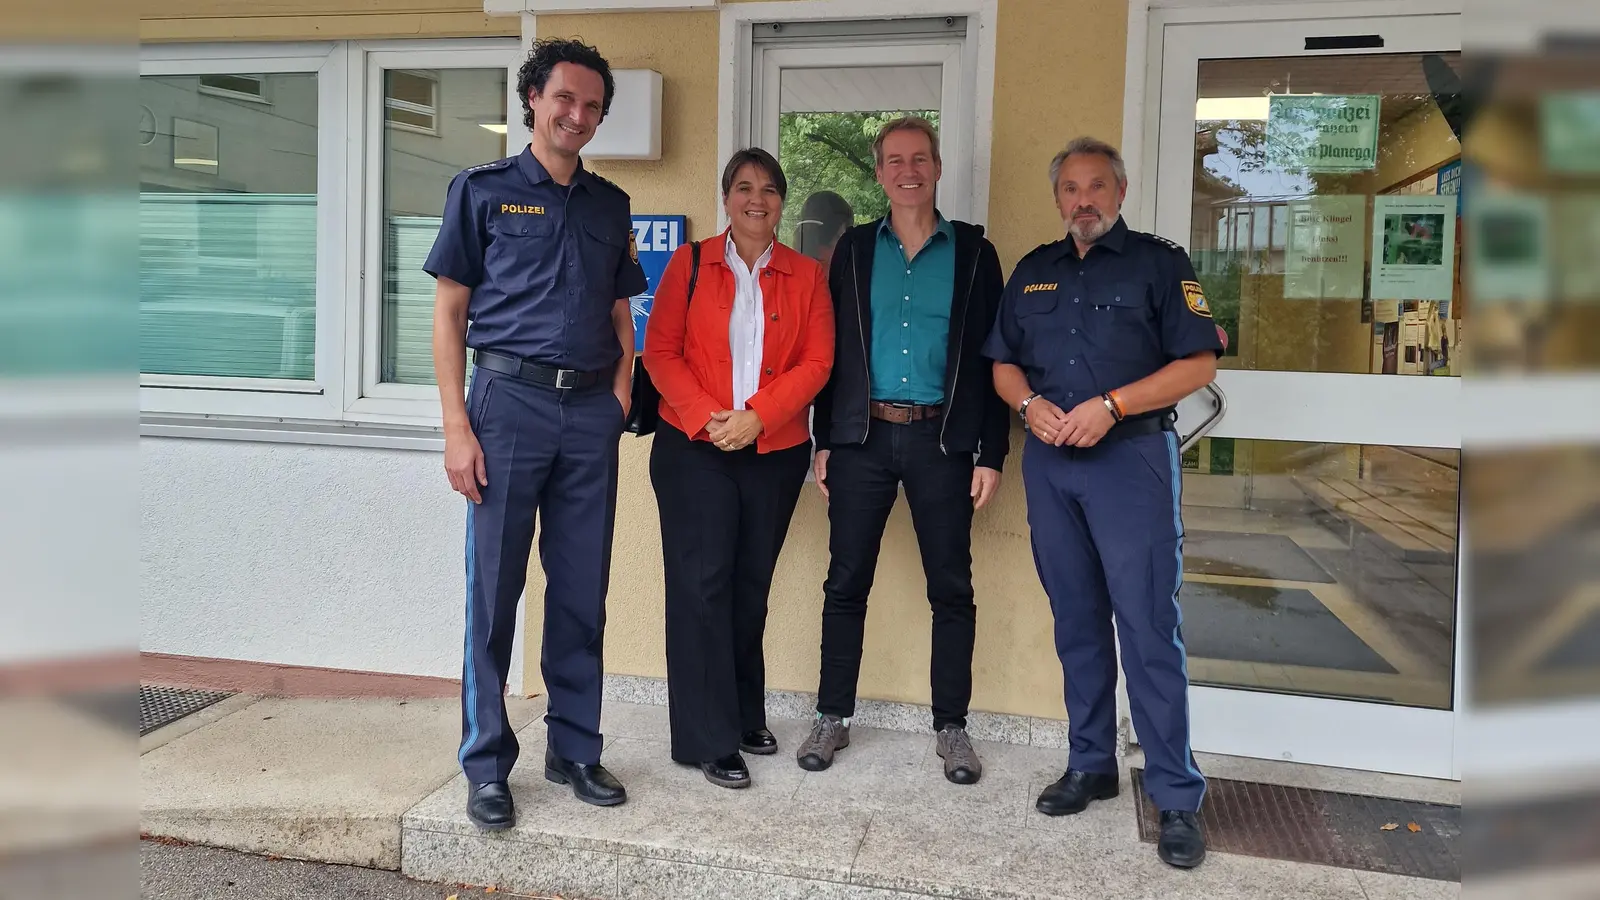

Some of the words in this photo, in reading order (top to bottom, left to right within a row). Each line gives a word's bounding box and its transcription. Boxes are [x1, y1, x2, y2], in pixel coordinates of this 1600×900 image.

[1319, 143, 1371, 161] Planegg
[502, 204, 544, 214] POLIZEI
[632, 220, 678, 252] ZEI
[1024, 283, 1058, 294] POLIZEI
